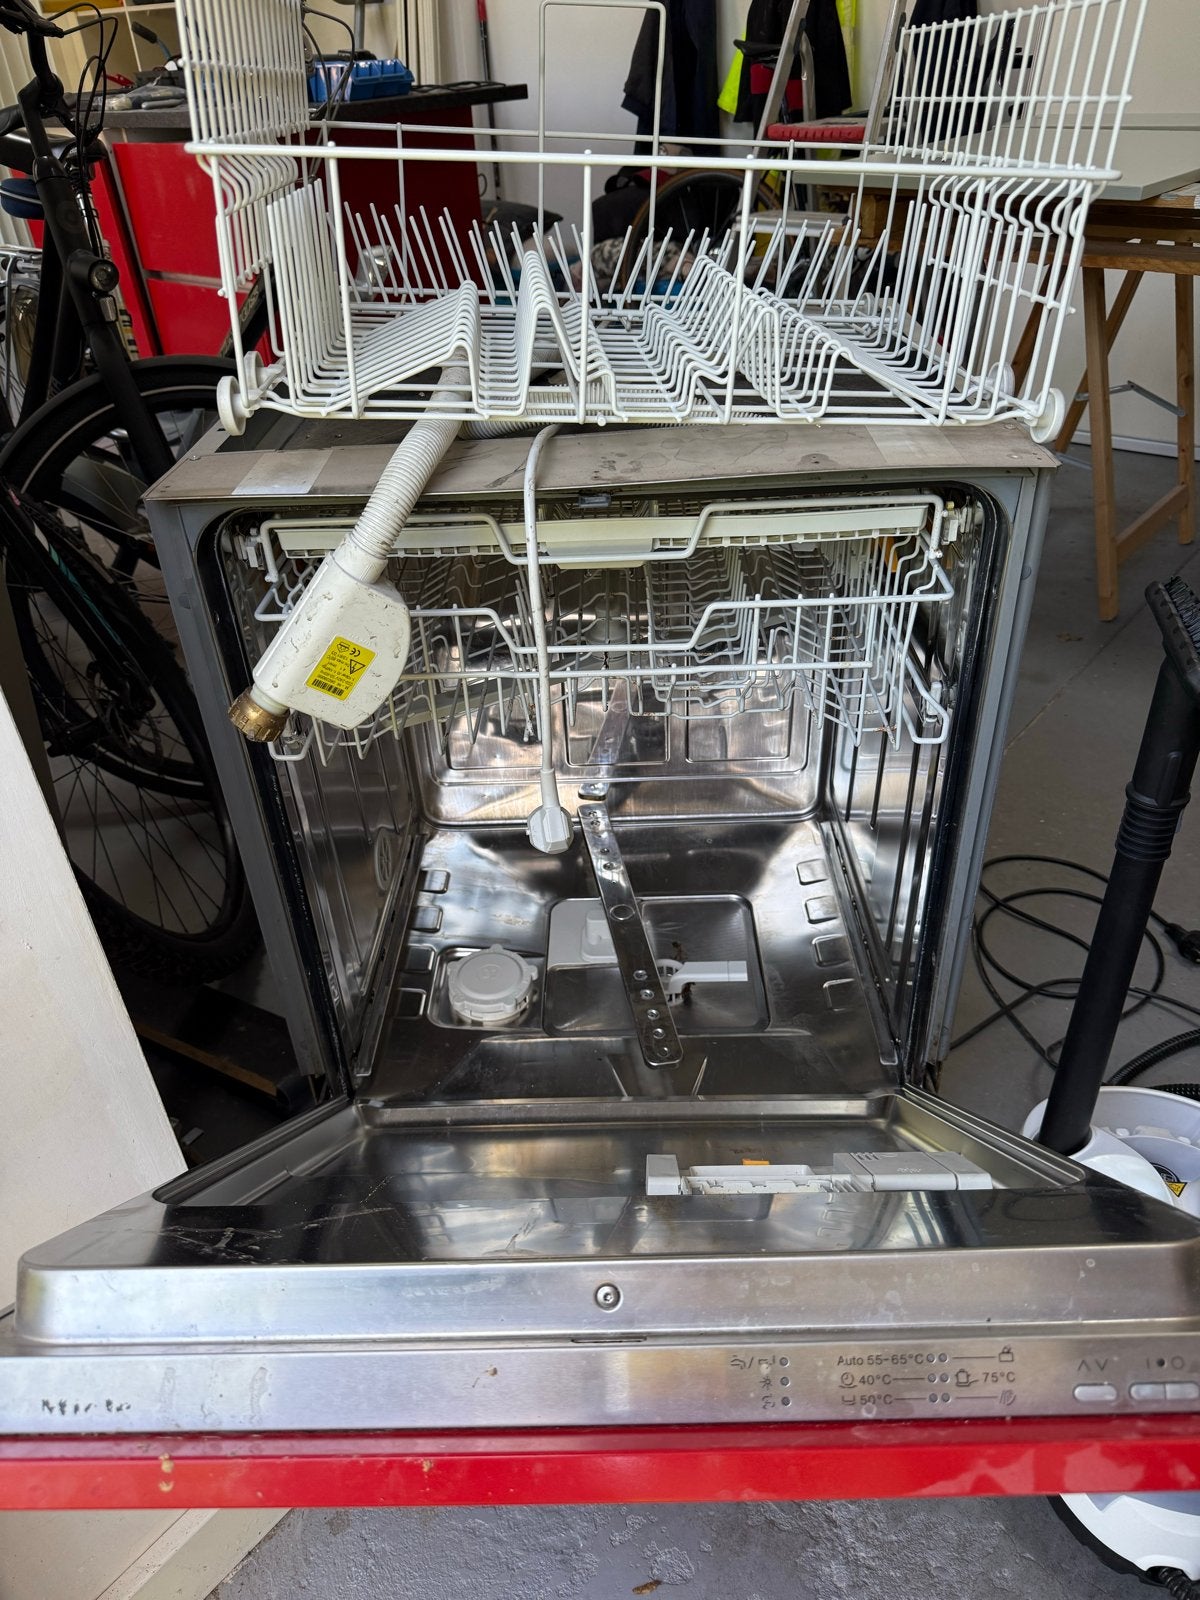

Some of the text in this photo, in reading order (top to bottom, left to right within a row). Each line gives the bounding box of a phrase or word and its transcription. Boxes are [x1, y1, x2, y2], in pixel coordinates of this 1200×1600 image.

[837, 1353, 924, 1366] Auto 55-65°C
[858, 1373, 892, 1385] 40°C
[982, 1371, 1016, 1383] 75°C
